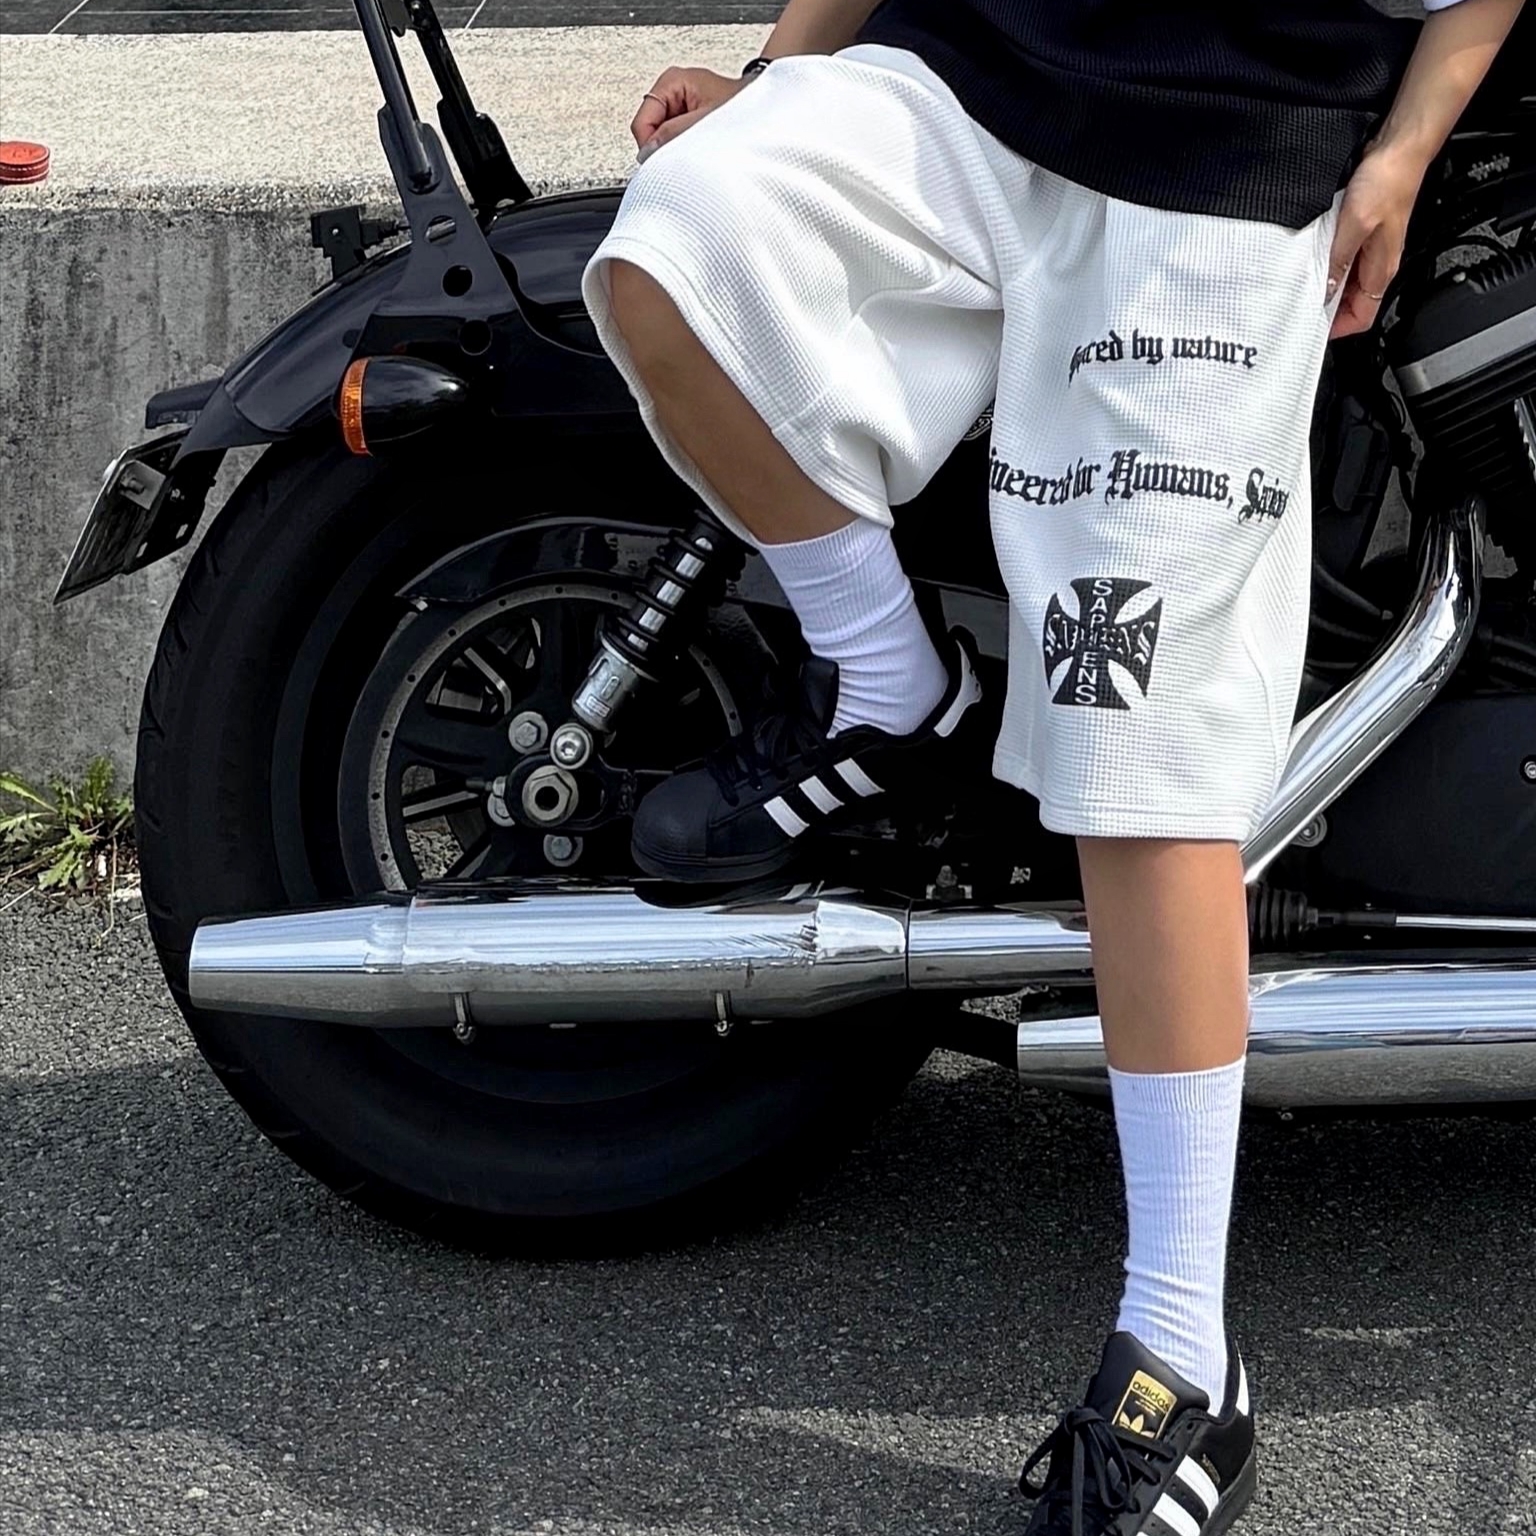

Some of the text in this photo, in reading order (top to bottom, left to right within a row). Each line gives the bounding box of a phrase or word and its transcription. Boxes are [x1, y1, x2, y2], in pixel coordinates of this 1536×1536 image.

[1132, 328, 1164, 365] by
[1172, 335, 1258, 369] nature
[1104, 449, 1233, 510] Humans,
[1132, 1381, 1171, 1412] adidas
